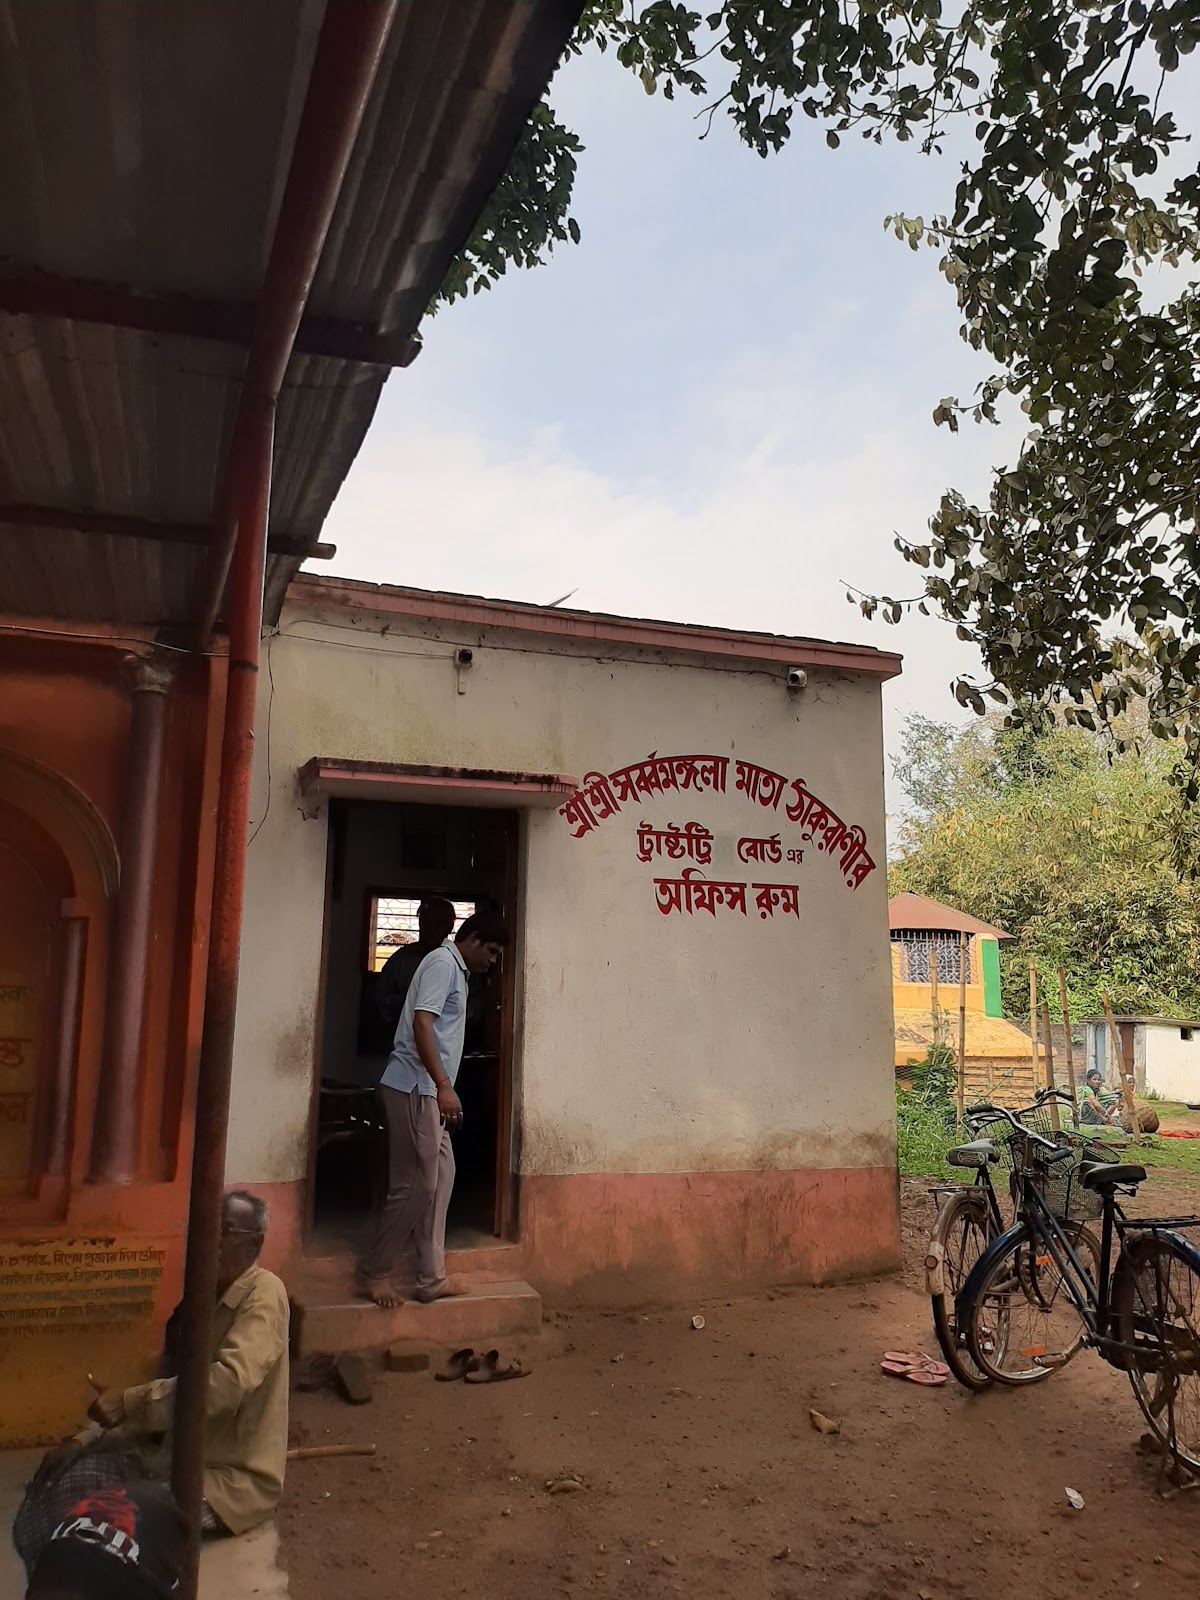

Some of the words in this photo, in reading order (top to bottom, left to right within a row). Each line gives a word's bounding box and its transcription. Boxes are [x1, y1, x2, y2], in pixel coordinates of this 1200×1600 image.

[735, 759, 788, 811] মাতা
[785, 778, 877, 891] ঠাকুরাণীর
[737, 832, 783, 864] বোর্ড
[786, 849, 805, 865] এর
[653, 867, 748, 918] অফিস
[752, 883, 800, 920] রুম
